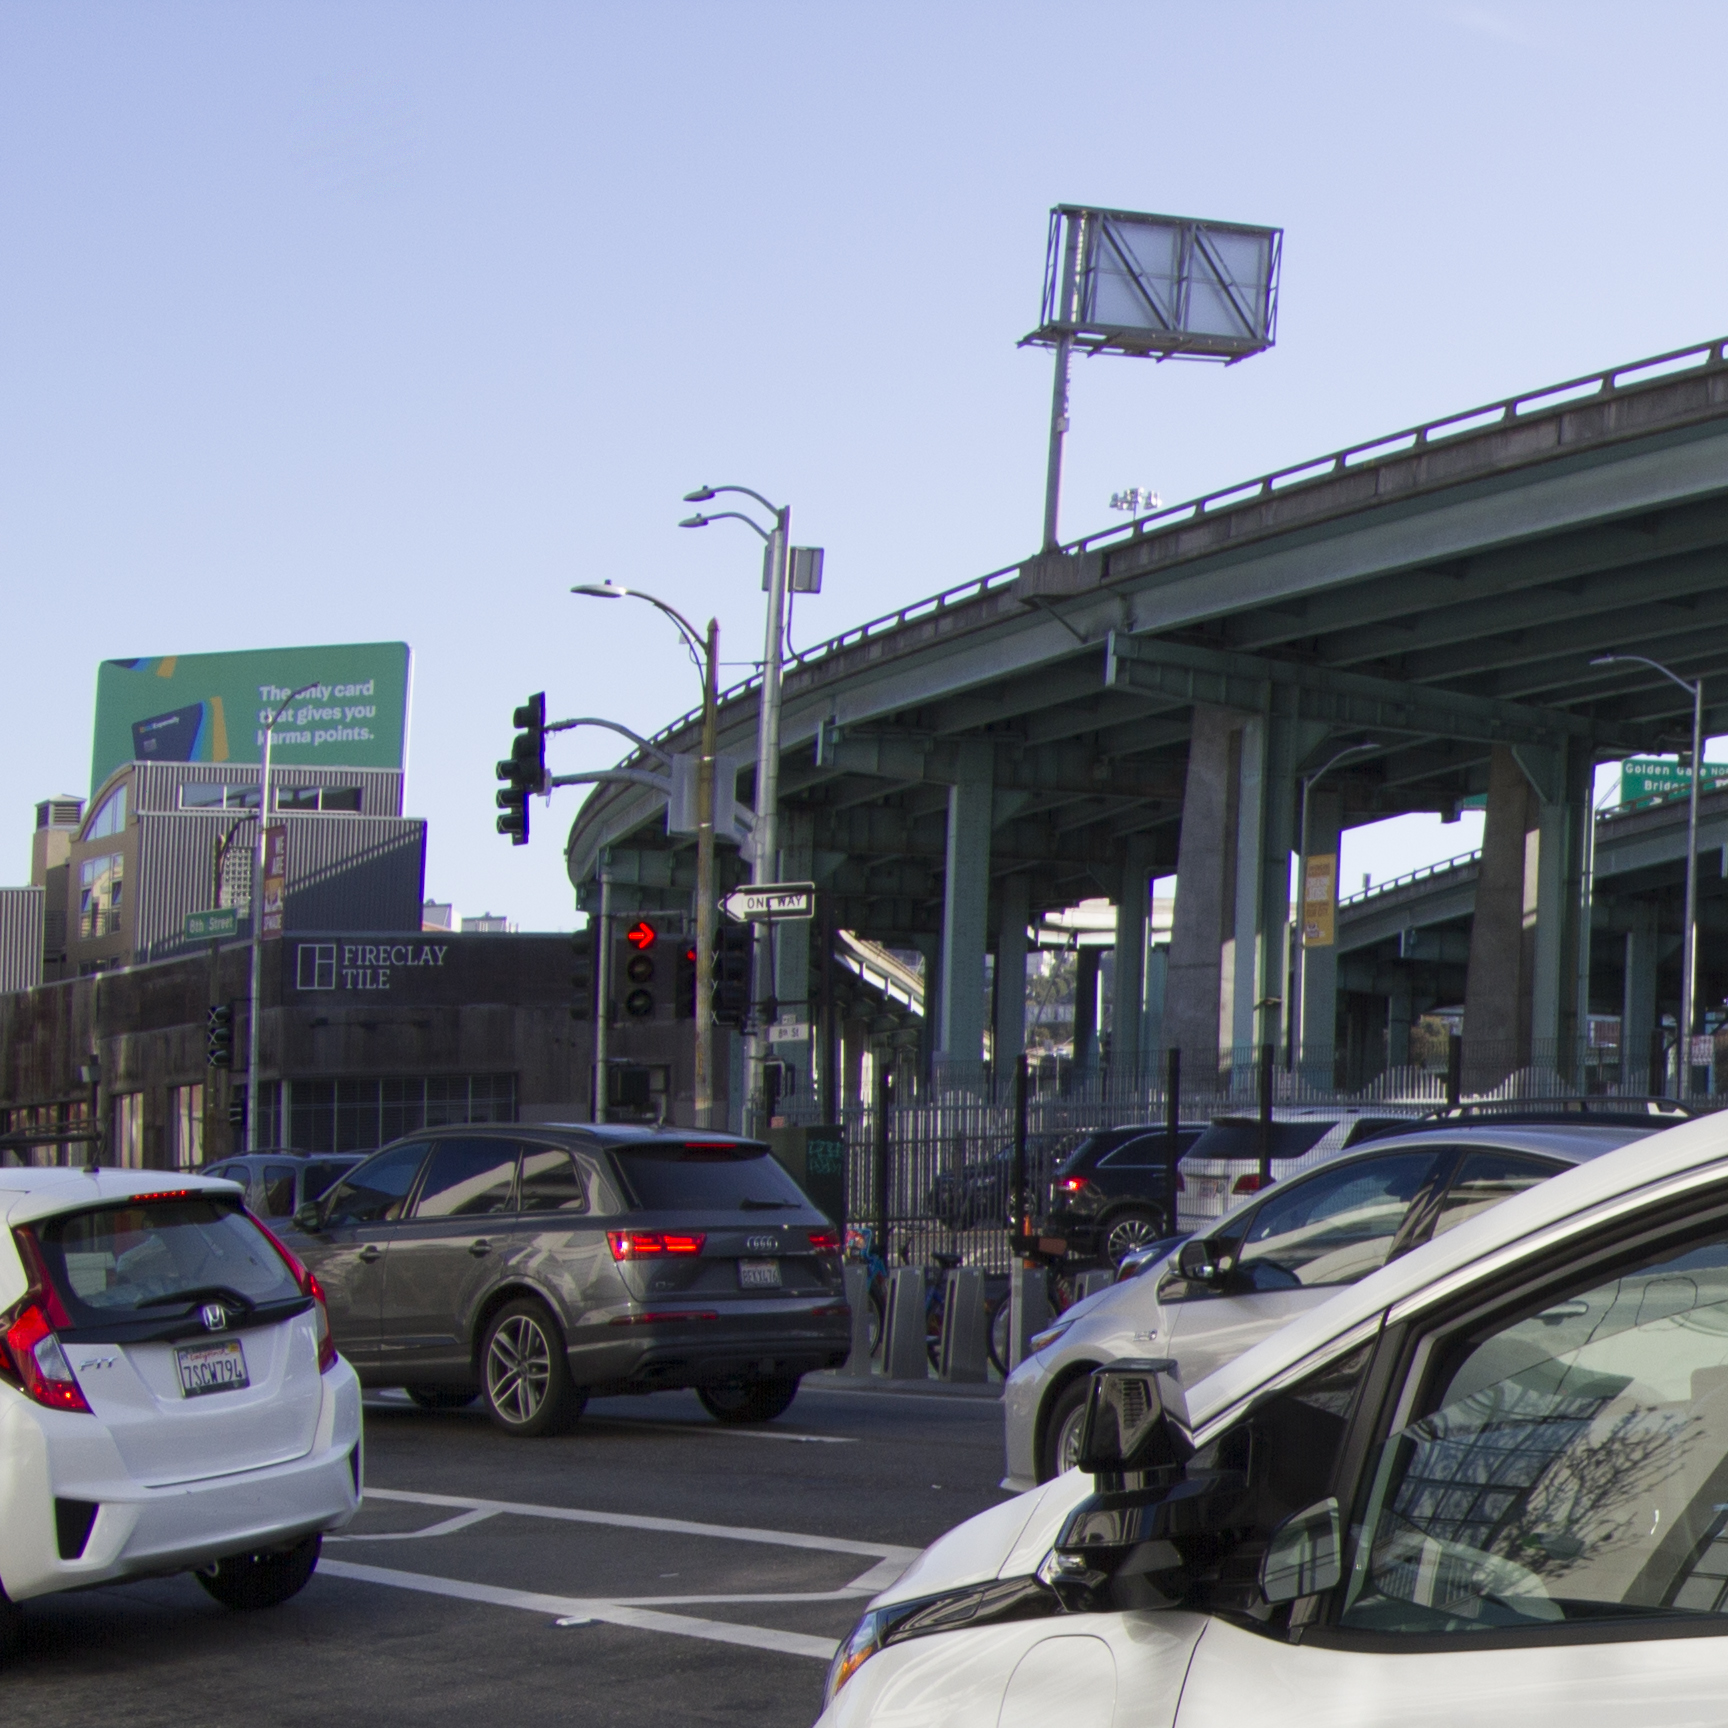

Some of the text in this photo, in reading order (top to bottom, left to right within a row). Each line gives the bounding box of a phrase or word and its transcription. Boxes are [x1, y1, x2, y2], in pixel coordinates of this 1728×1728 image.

[259, 685, 291, 701] The
[334, 679, 374, 698] card
[297, 706, 341, 726] gives
[343, 705, 376, 723] you
[313, 725, 374, 746] points.
[1625, 763, 1670, 775] Golden
[1676, 764, 1706, 776] Gae
[747, 895, 803, 909] ON WAY
[189, 915, 233, 933] 8th Street
[343, 945, 448, 966] FIRECLAY
[343, 969, 390, 989] TILE
[79, 1356, 118, 1371] FIT
[183, 1359, 243, 1388] 7SCW794
